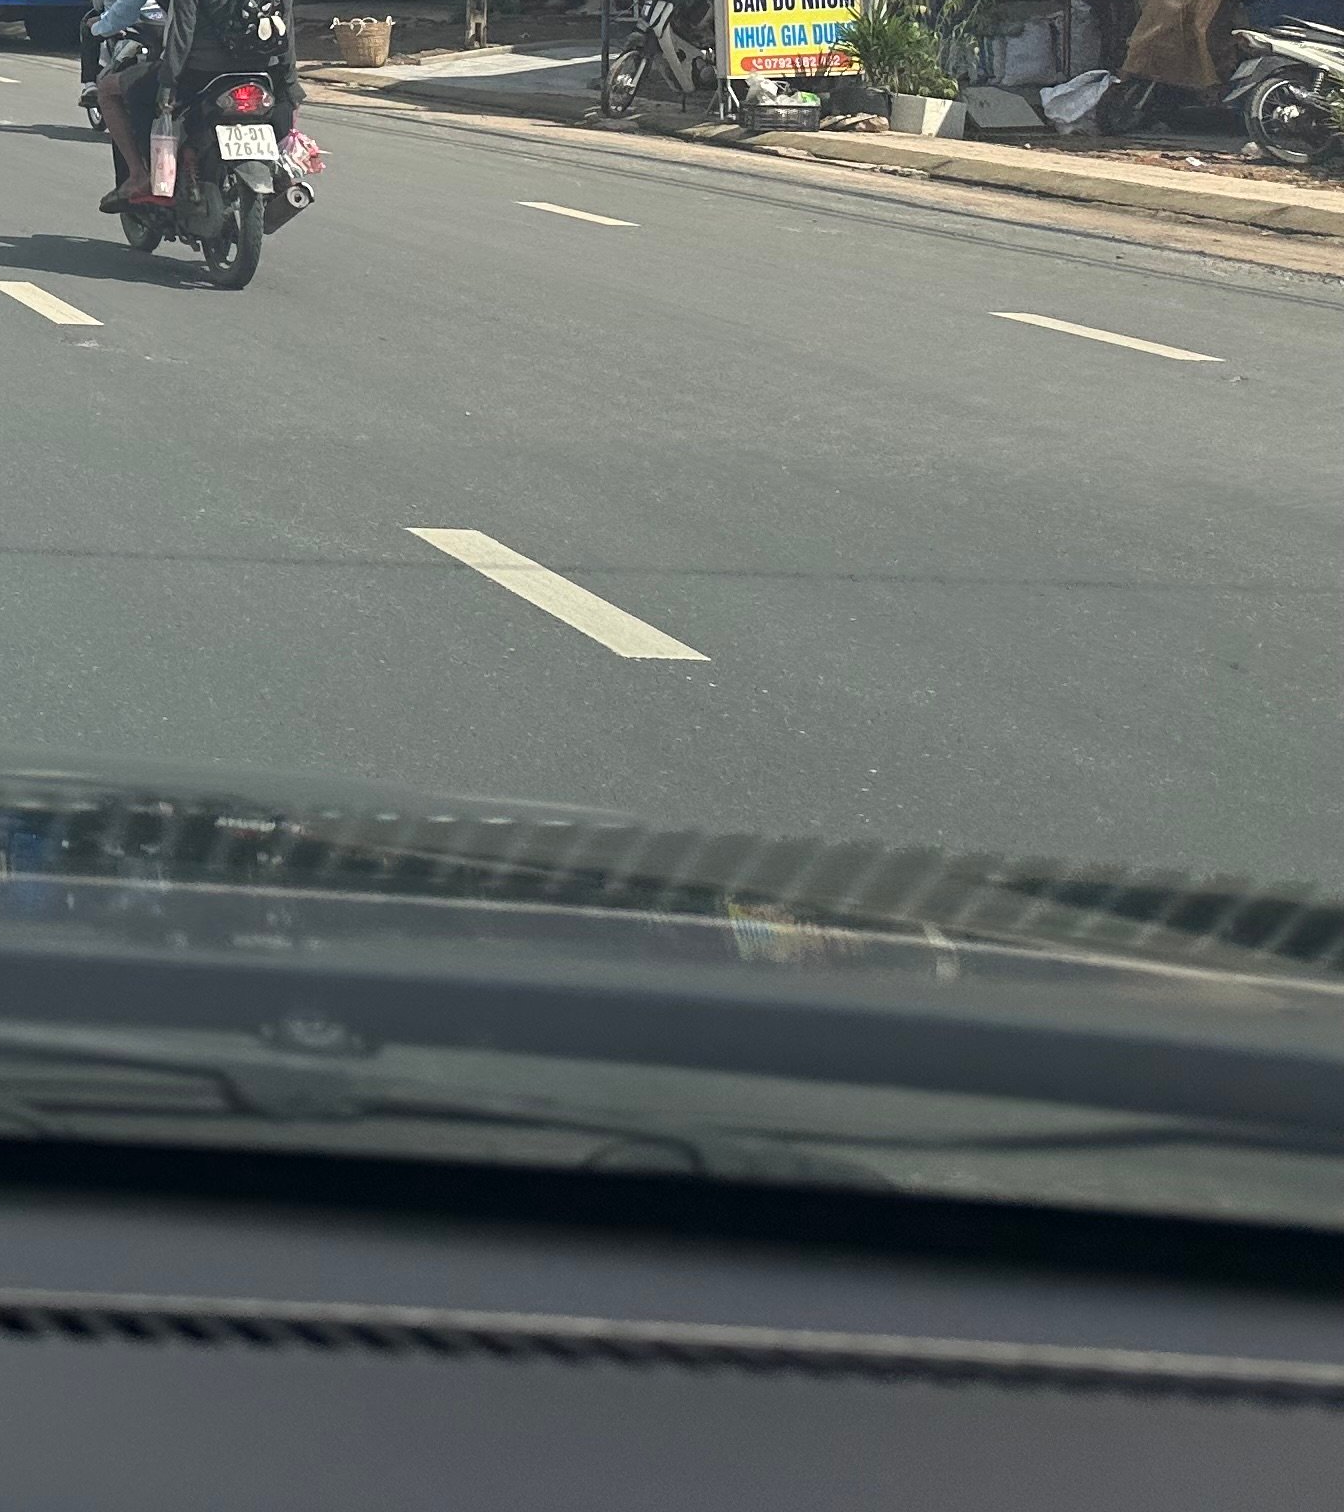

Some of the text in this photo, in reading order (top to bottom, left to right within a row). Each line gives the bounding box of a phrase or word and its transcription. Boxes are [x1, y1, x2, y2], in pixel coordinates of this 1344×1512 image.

[734, 24, 777, 52] NHỰA
[781, 24, 808, 47] GIA
[765, 57, 792, 69] 0792
